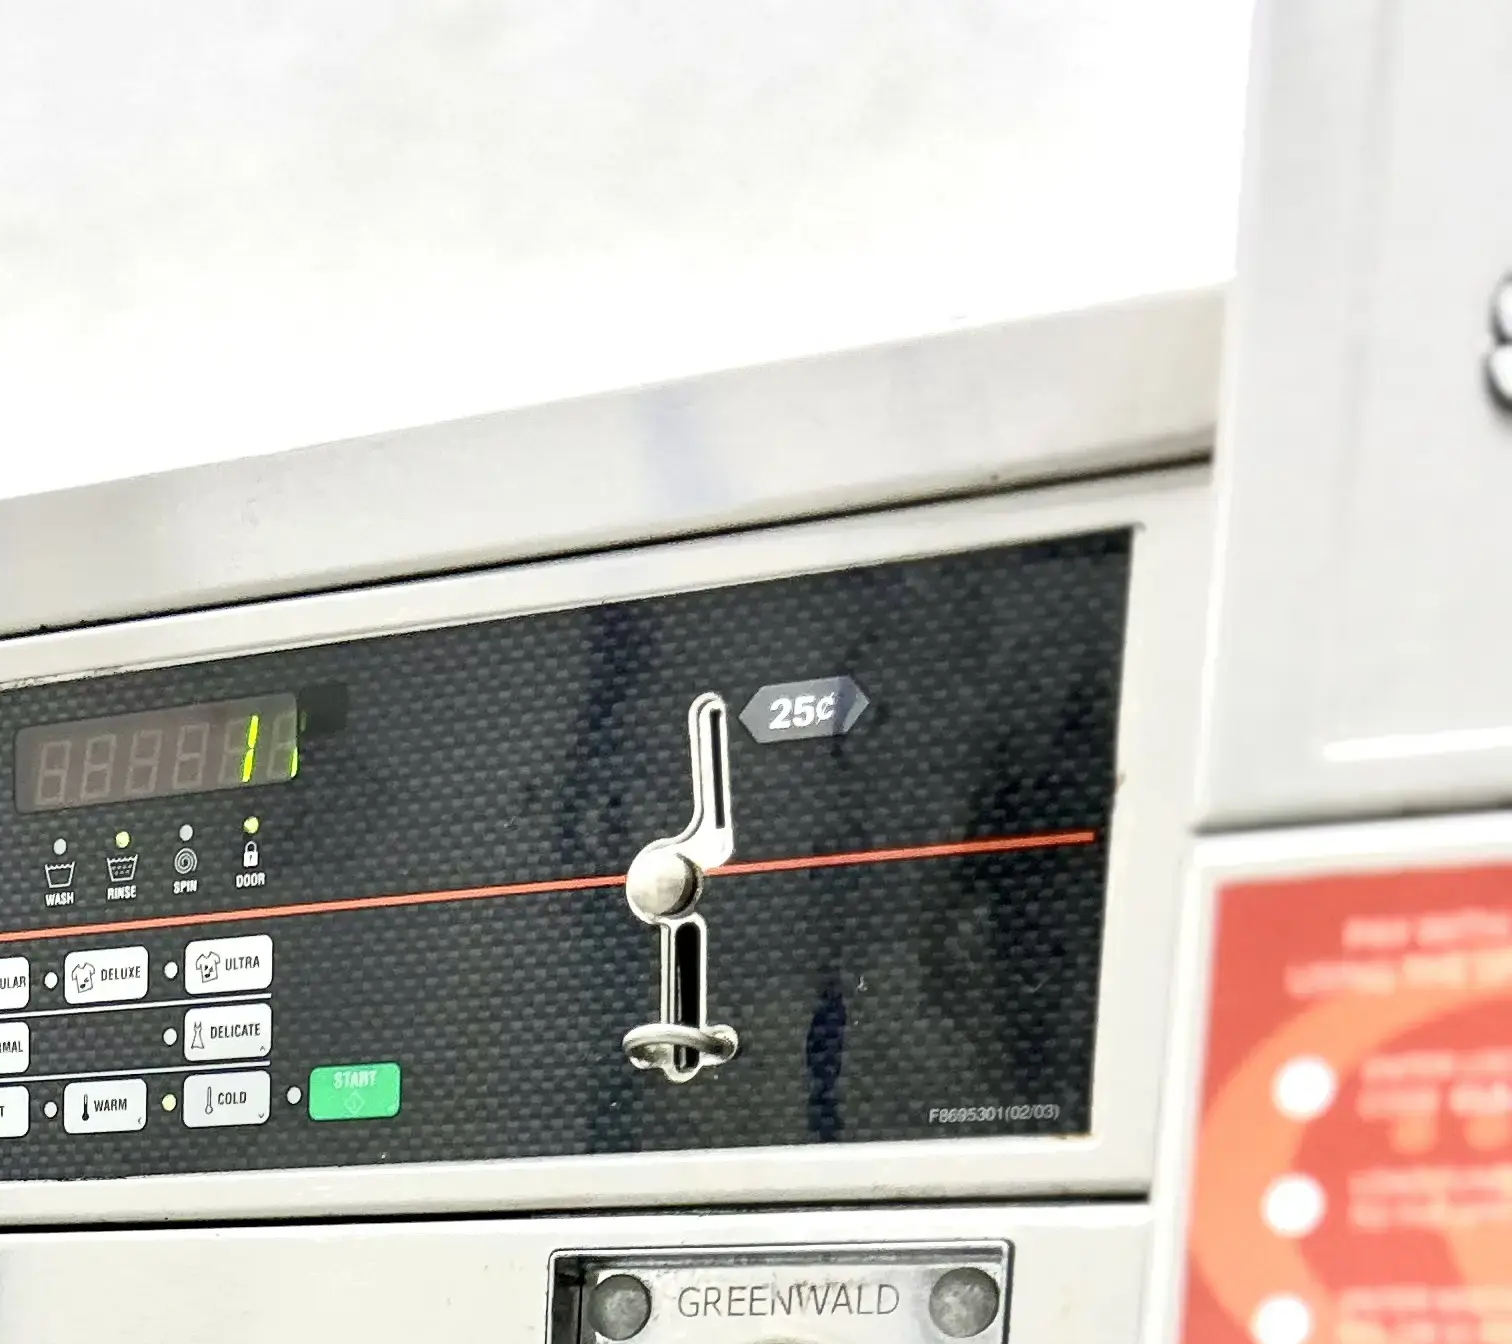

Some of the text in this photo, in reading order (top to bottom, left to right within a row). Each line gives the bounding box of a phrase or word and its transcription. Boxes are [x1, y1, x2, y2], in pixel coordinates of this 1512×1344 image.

[768, 691, 836, 730] 25¢
[173, 879, 198, 894] SPIN
[235, 872, 266, 888] DOOR
[45, 891, 75, 907] WASH
[107, 886, 137, 900] RINSE
[225, 956, 261, 972] ULTRA
[100, 966, 141, 982] DELUXE
[209, 1023, 261, 1039] DELICATE
[333, 1069, 378, 1090] START
[93, 1098, 128, 1113] WARM
[217, 1091, 248, 1106] COLD
[676, 1283, 901, 1318] GREENWALD
